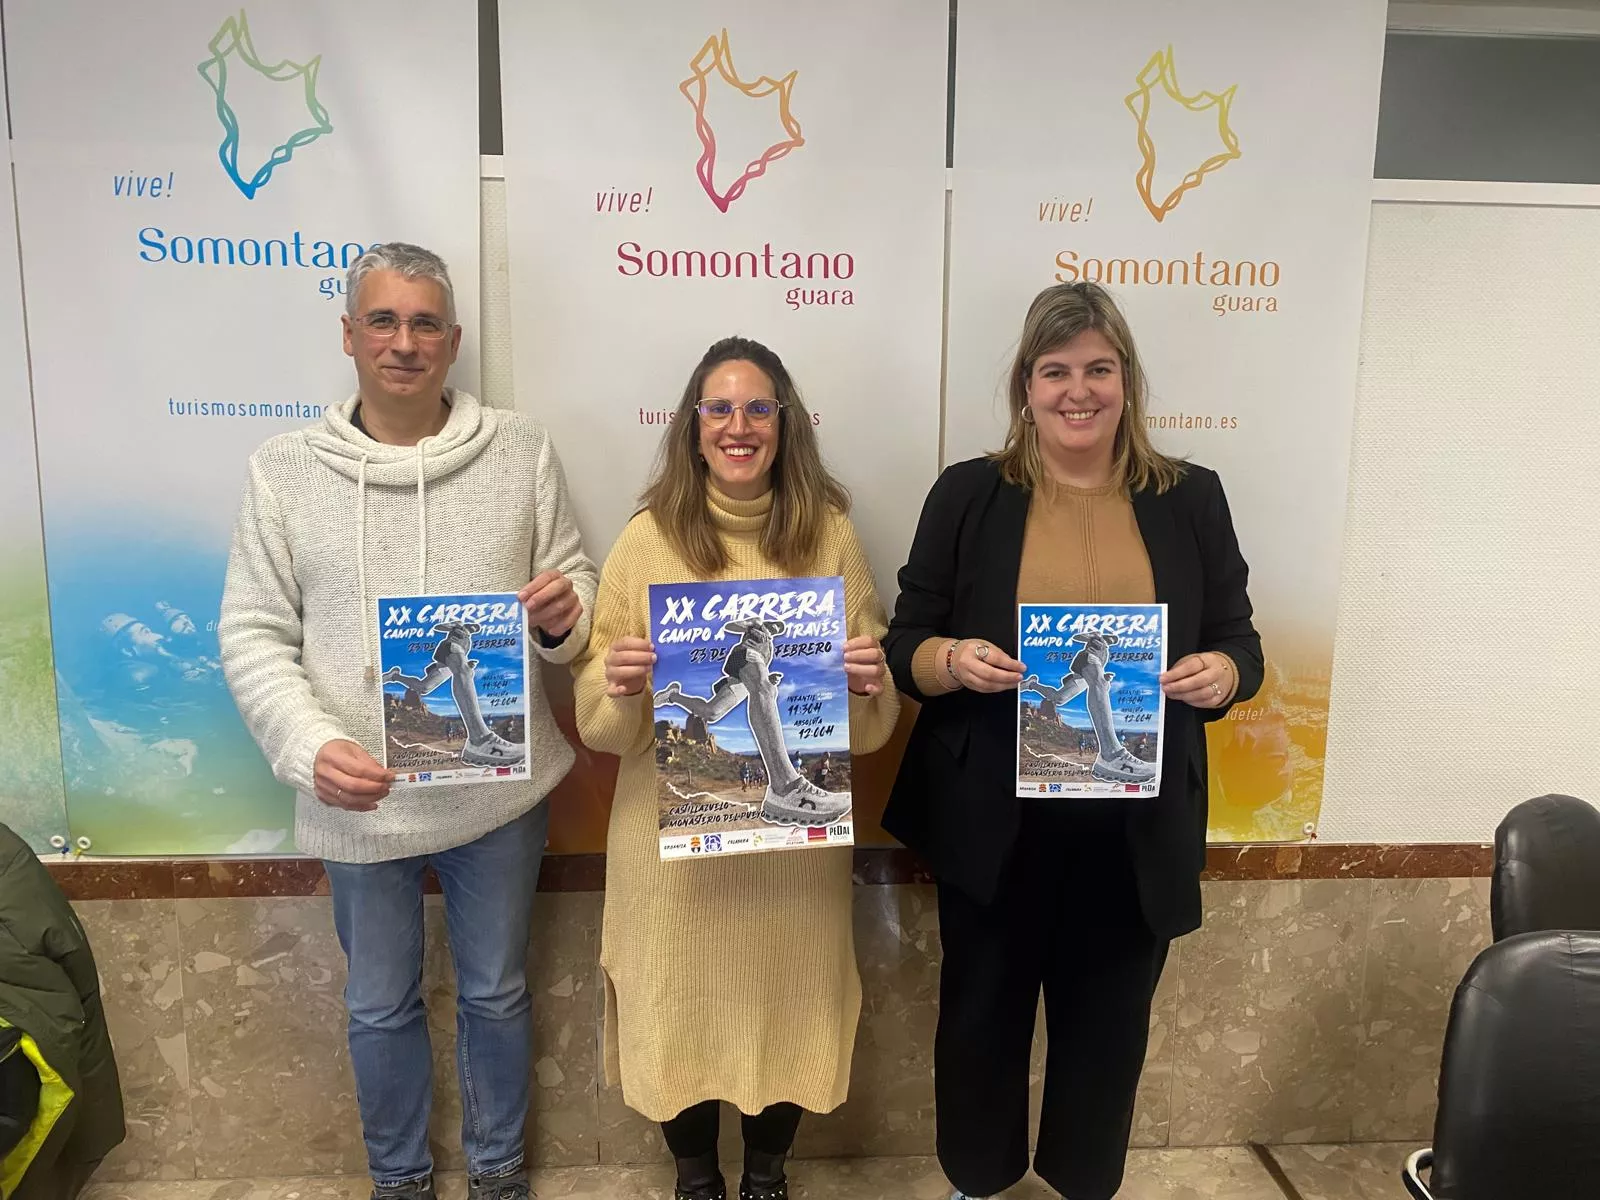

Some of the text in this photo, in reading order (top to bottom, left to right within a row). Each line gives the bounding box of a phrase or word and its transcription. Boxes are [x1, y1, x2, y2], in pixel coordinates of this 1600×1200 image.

[113, 170, 175, 198] vive!
[596, 187, 652, 212] vive!
[1038, 196, 1093, 222] vive!
[617, 241, 855, 280] Somontano
[1054, 250, 1280, 287] Somontano
[785, 287, 855, 311] guara
[1212, 294, 1279, 317] guara
[168, 397, 328, 419] turismosomontan
[1145, 412, 1238, 429] montano.es
[384, 602, 519, 626] XX CARRERA
[659, 589, 835, 625] XX CARRERA
[383, 623, 522, 640] CAMPO A TRAVÉS
[658, 619, 840, 643] CAMPO A TRAVÉS
[1025, 613, 1160, 635] XX CARRERA
[472, 638, 516, 650] FEBRERO
[690, 641, 832, 663] 23 DE FEBRERO
[1023, 633, 1161, 649] CAMPO A TRAVÉS
[1109, 651, 1154, 662] FEBRERO
[669, 813, 721, 828] MONASTERIO
